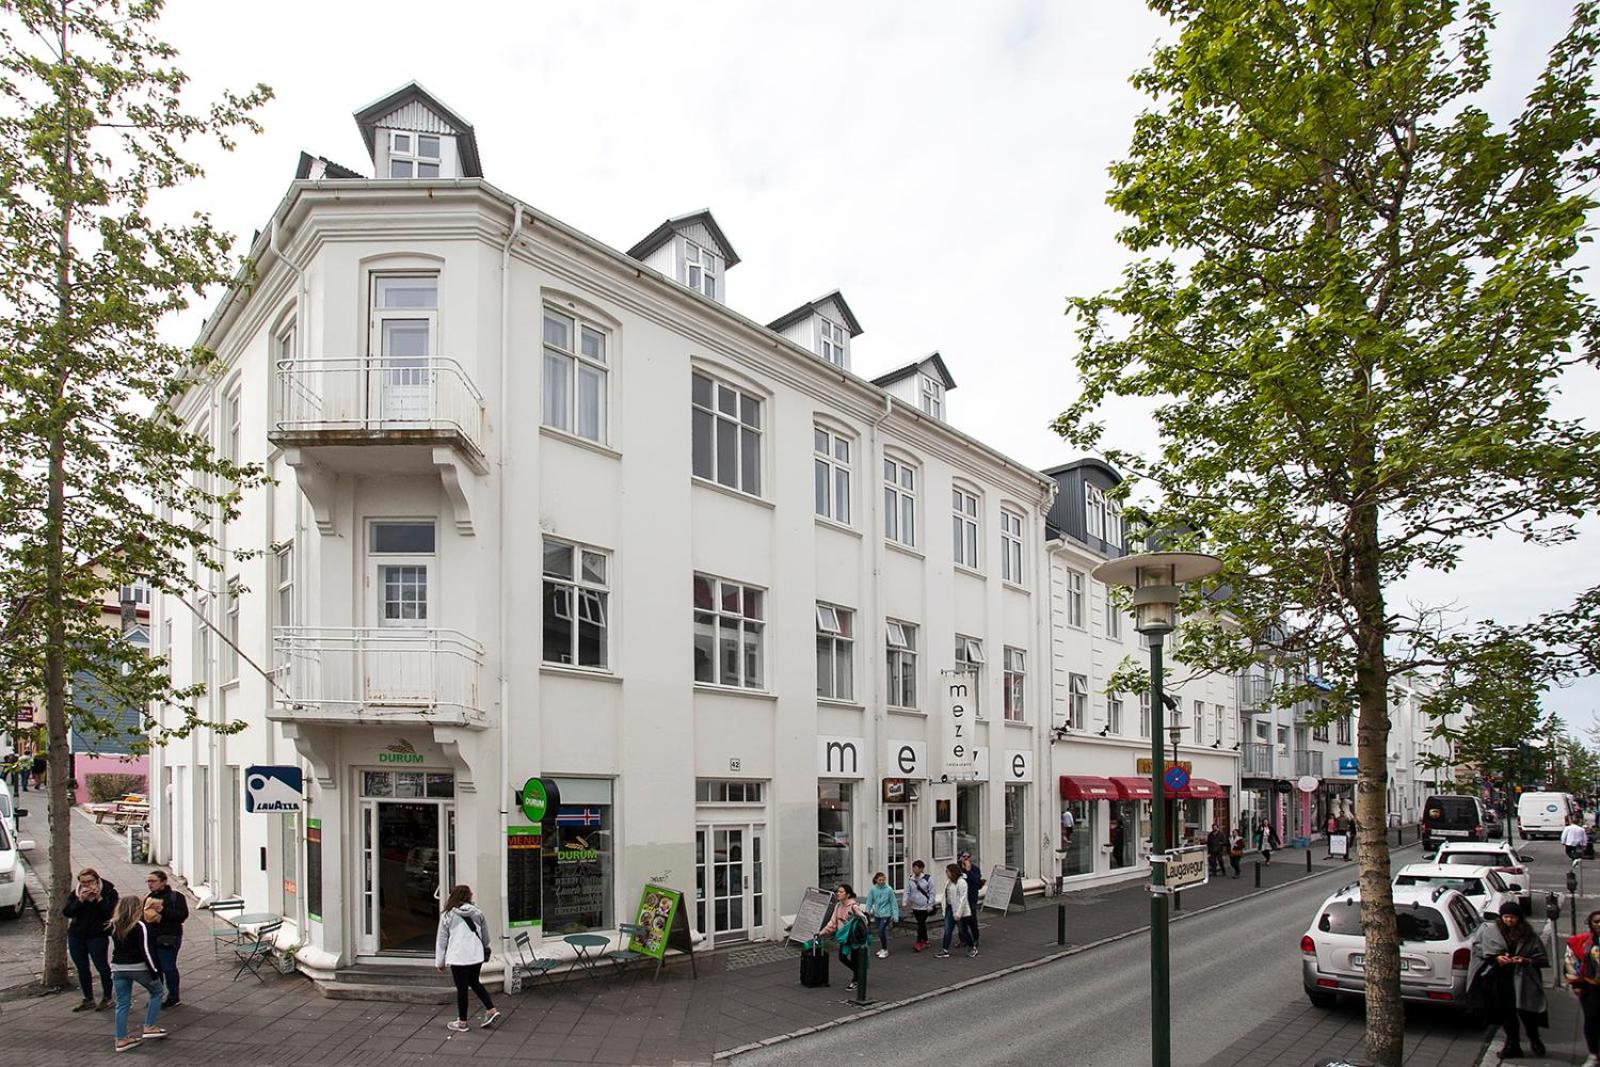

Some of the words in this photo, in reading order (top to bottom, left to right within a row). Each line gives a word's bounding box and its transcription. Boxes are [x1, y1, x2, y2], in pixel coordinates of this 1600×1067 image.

[950, 684, 968, 758] meze
[379, 753, 424, 764] DURUM
[256, 800, 300, 810] LAVAZZA
[558, 849, 598, 860] DURUM
